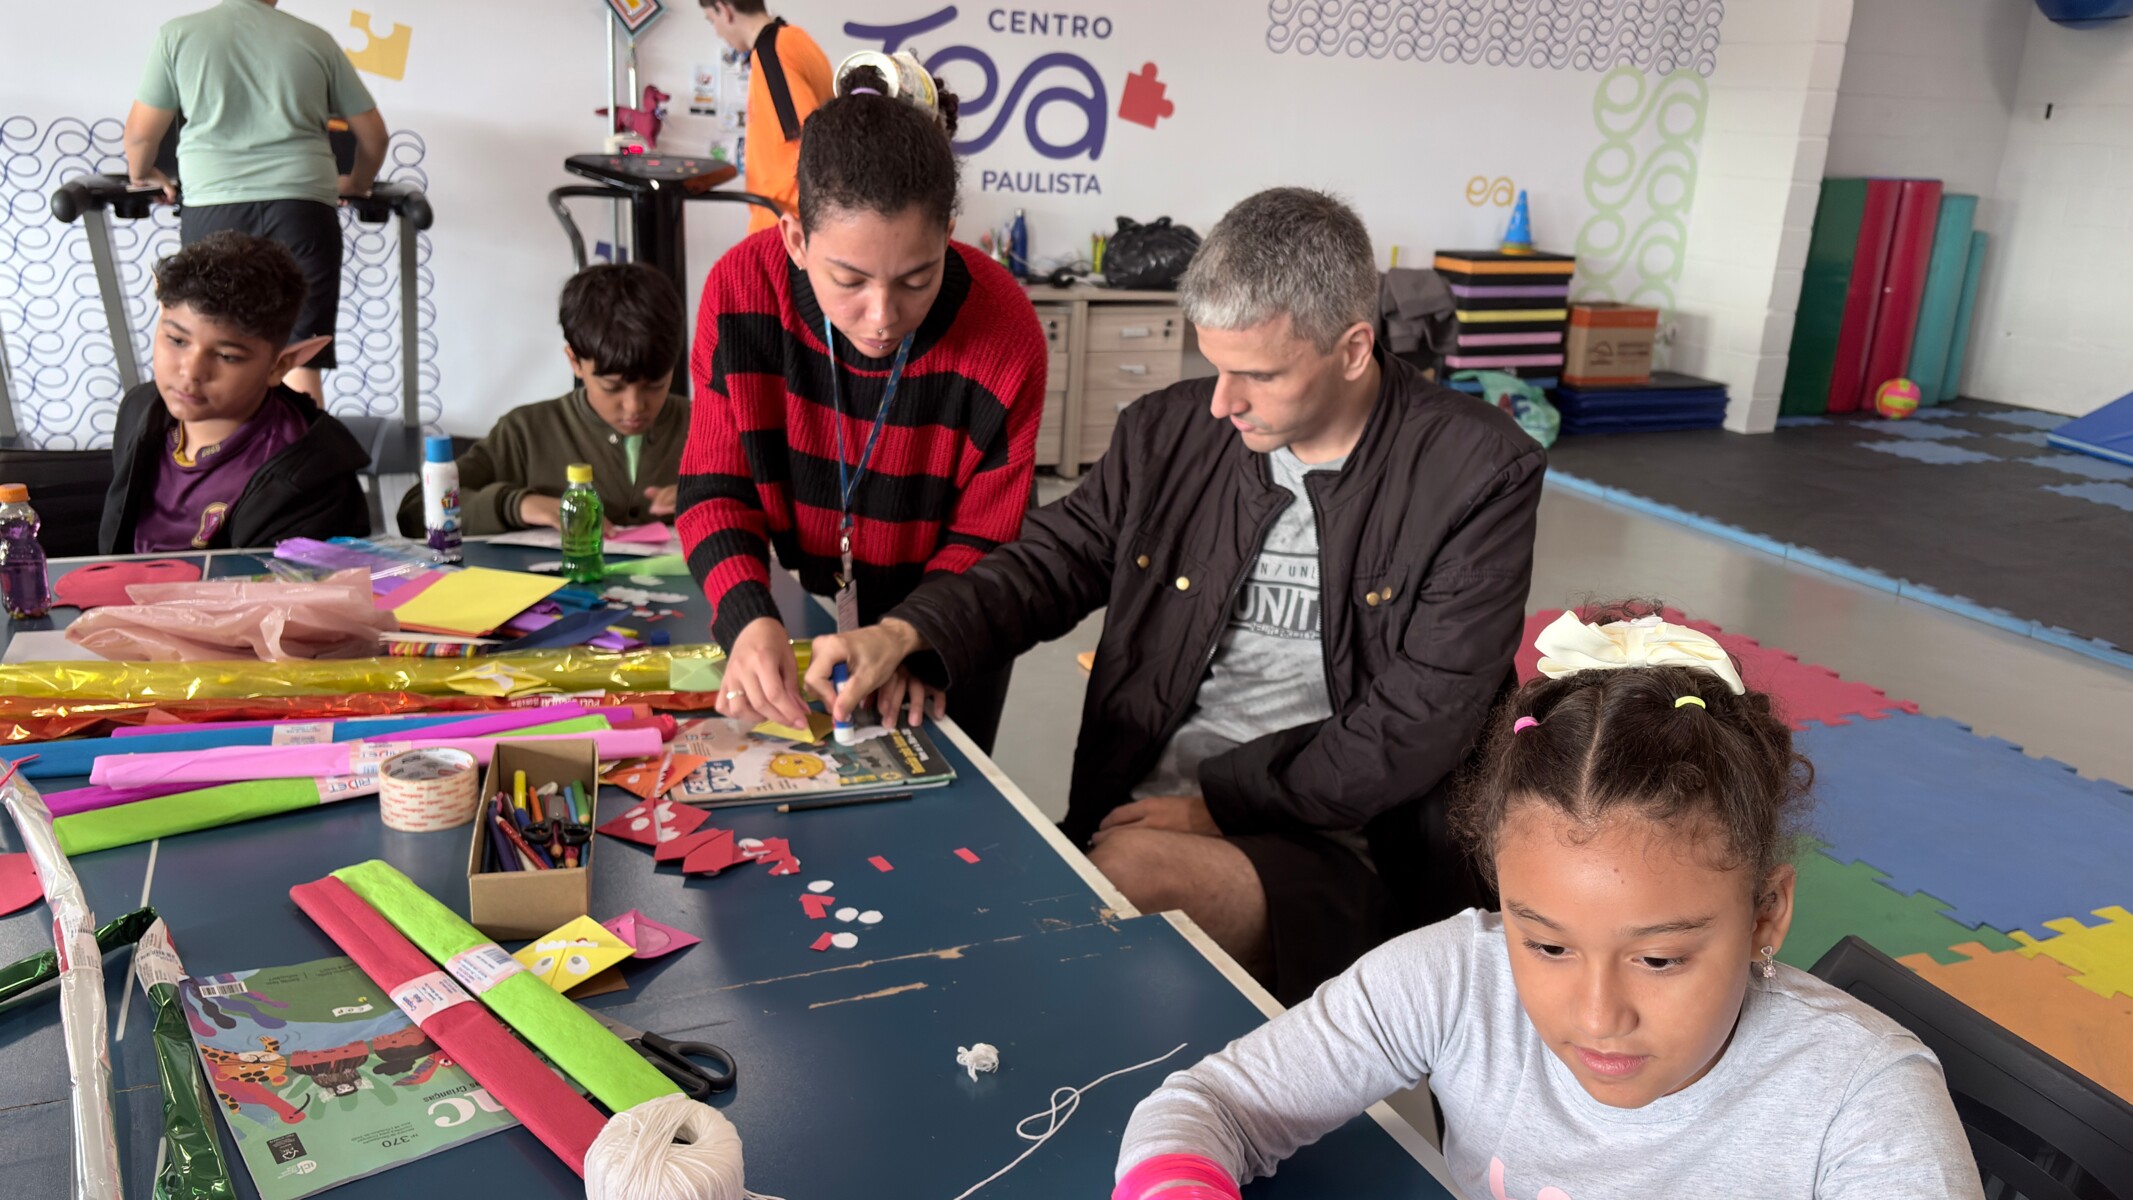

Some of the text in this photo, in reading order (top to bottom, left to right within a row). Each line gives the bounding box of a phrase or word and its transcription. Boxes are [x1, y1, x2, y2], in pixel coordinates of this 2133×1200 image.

[988, 8, 1113, 40] CENTRO
[981, 169, 1102, 195] PAULISTA
[1232, 583, 1321, 632] UNIT
[381, 1135, 411, 1148] 370
